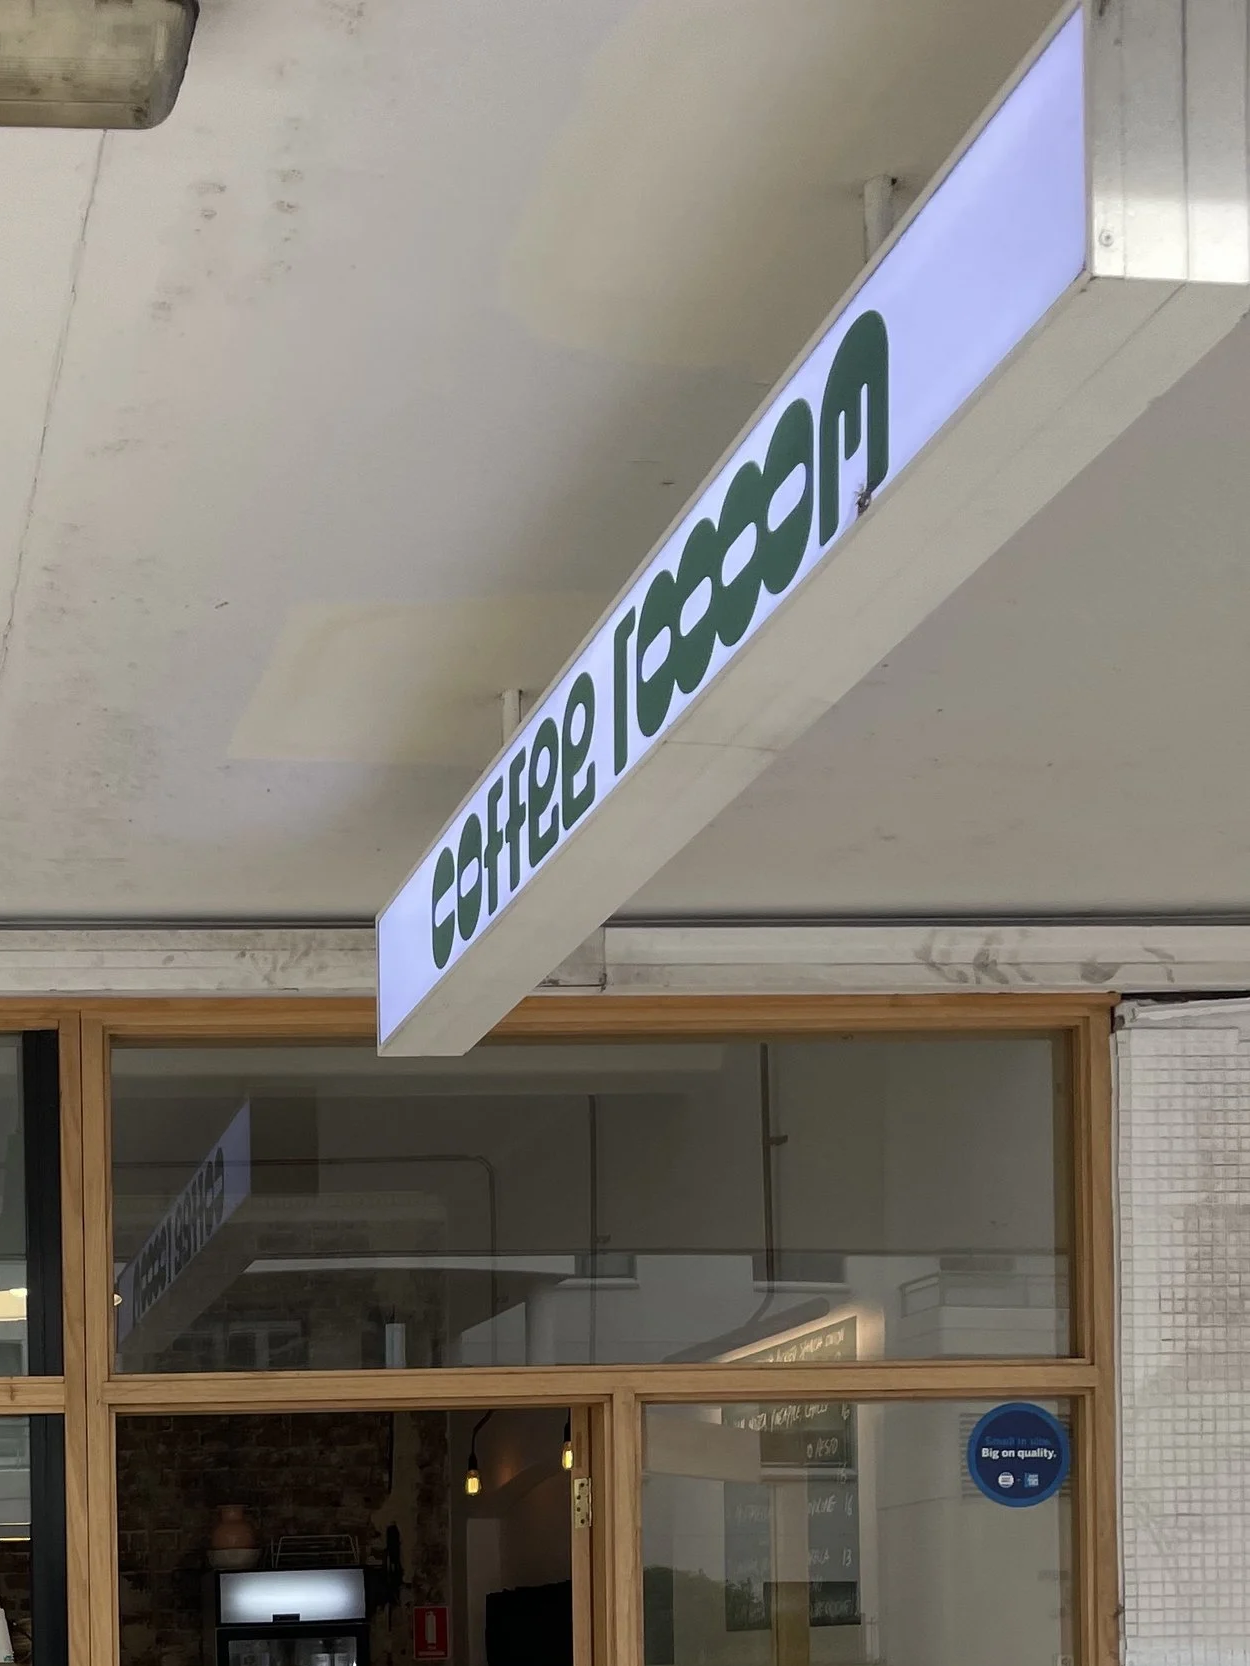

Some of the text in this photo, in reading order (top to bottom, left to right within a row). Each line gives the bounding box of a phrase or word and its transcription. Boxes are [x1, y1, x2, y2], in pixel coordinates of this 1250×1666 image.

[431, 671, 597, 970] coffee
[981, 1448, 999, 1459] Big
[1017, 1448, 1057, 1459] quality.
